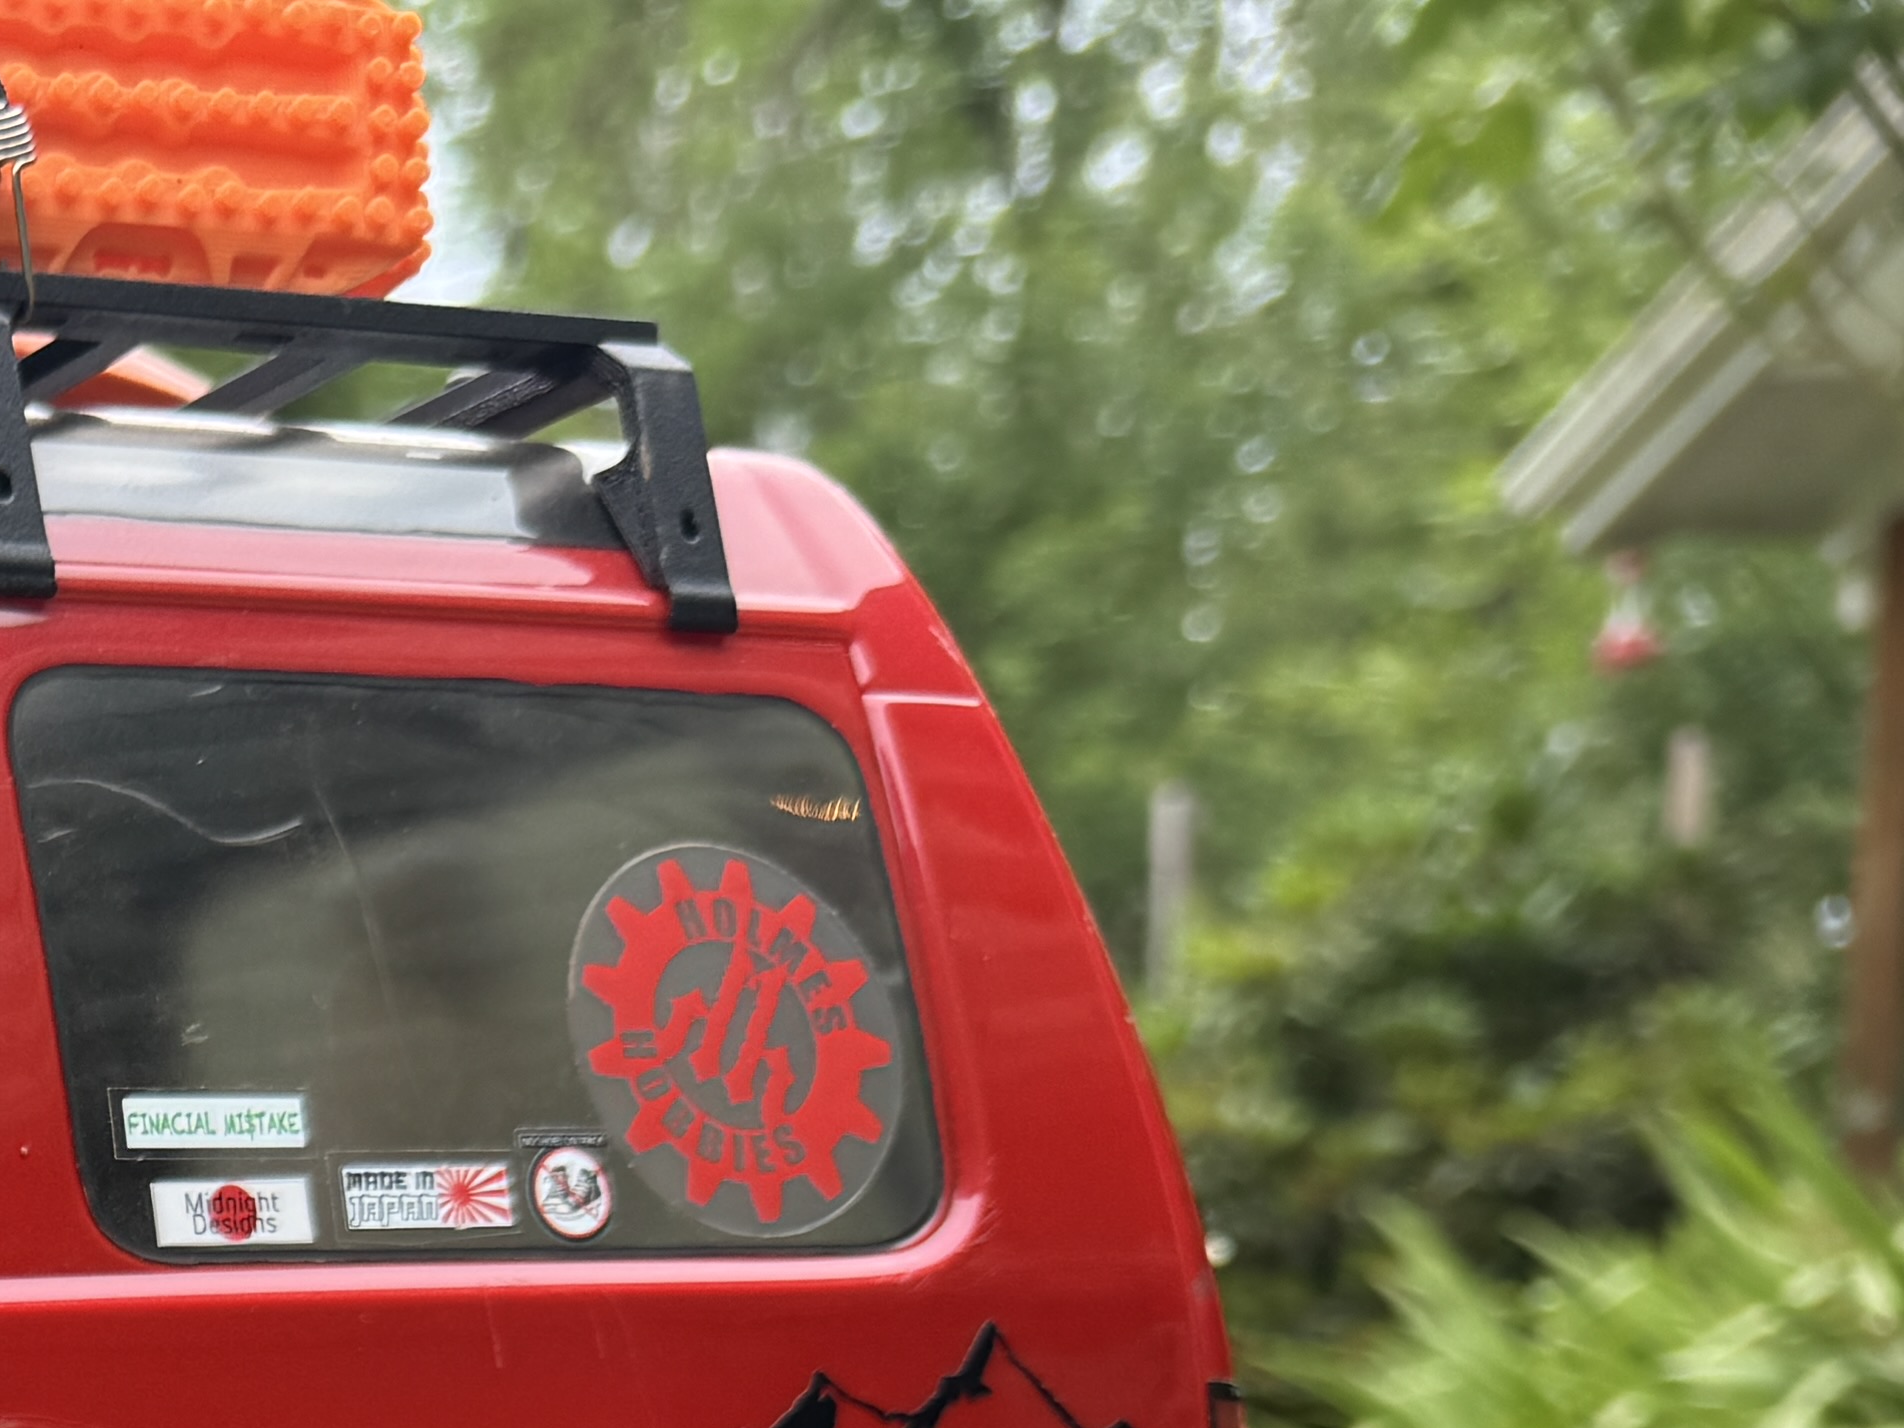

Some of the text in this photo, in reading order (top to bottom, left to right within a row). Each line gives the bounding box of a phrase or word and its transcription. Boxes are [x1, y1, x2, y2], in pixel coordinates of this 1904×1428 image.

[675, 897, 848, 1035] HOLMES
[620, 1030, 807, 1173] HOBBIES
[127, 1112, 217, 1136] FINACIAL
[347, 1171, 435, 1191] MADE IN
[184, 1193, 280, 1220] Midnight
[349, 1195, 439, 1228] JAPAN
[192, 1214, 277, 1239] Designs
